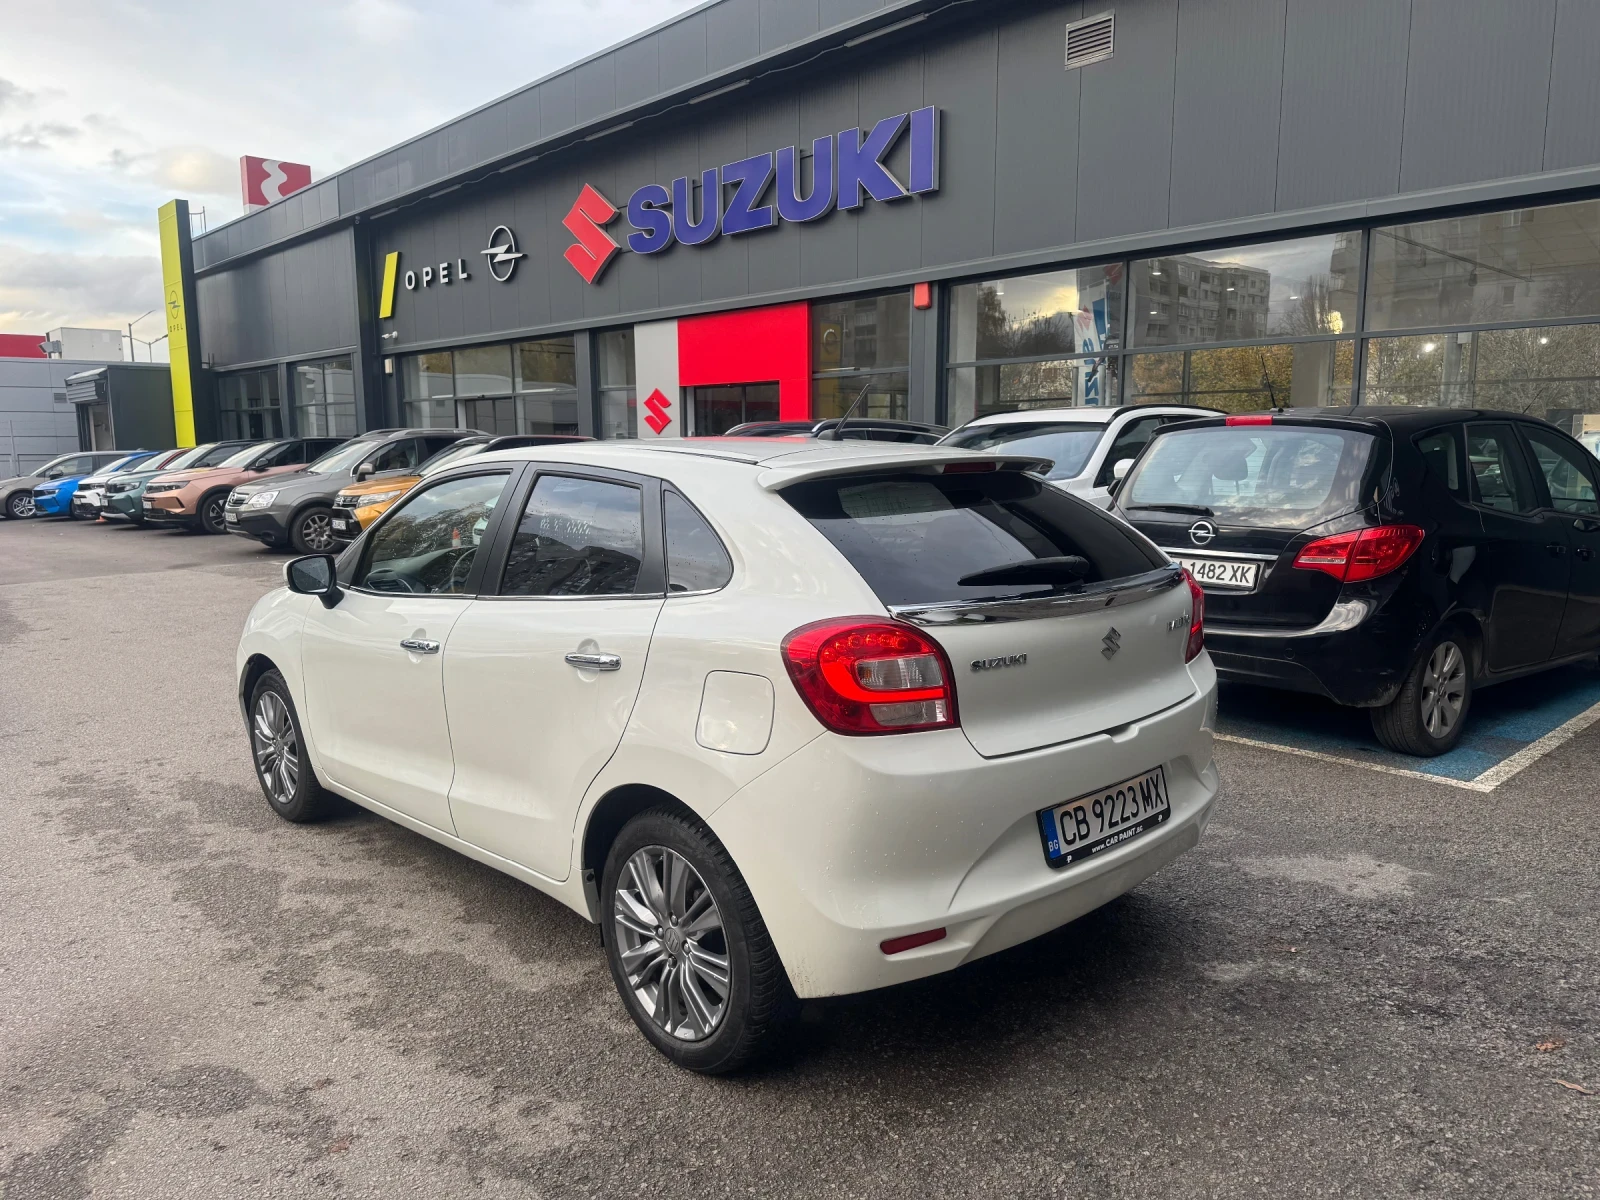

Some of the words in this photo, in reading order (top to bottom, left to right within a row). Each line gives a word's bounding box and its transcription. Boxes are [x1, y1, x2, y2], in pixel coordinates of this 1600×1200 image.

[627, 105, 940, 254] SUZUKI
[405, 258, 468, 290] OPEL
[1190, 562, 1226, 581] 1482
[1229, 564, 1252, 583] XK
[970, 652, 1027, 672] SUZUKI
[1060, 805, 1091, 846] CB
[1091, 785, 1140, 833] 9223
[1139, 773, 1164, 813] MX
[1048, 839, 1059, 852] BG
